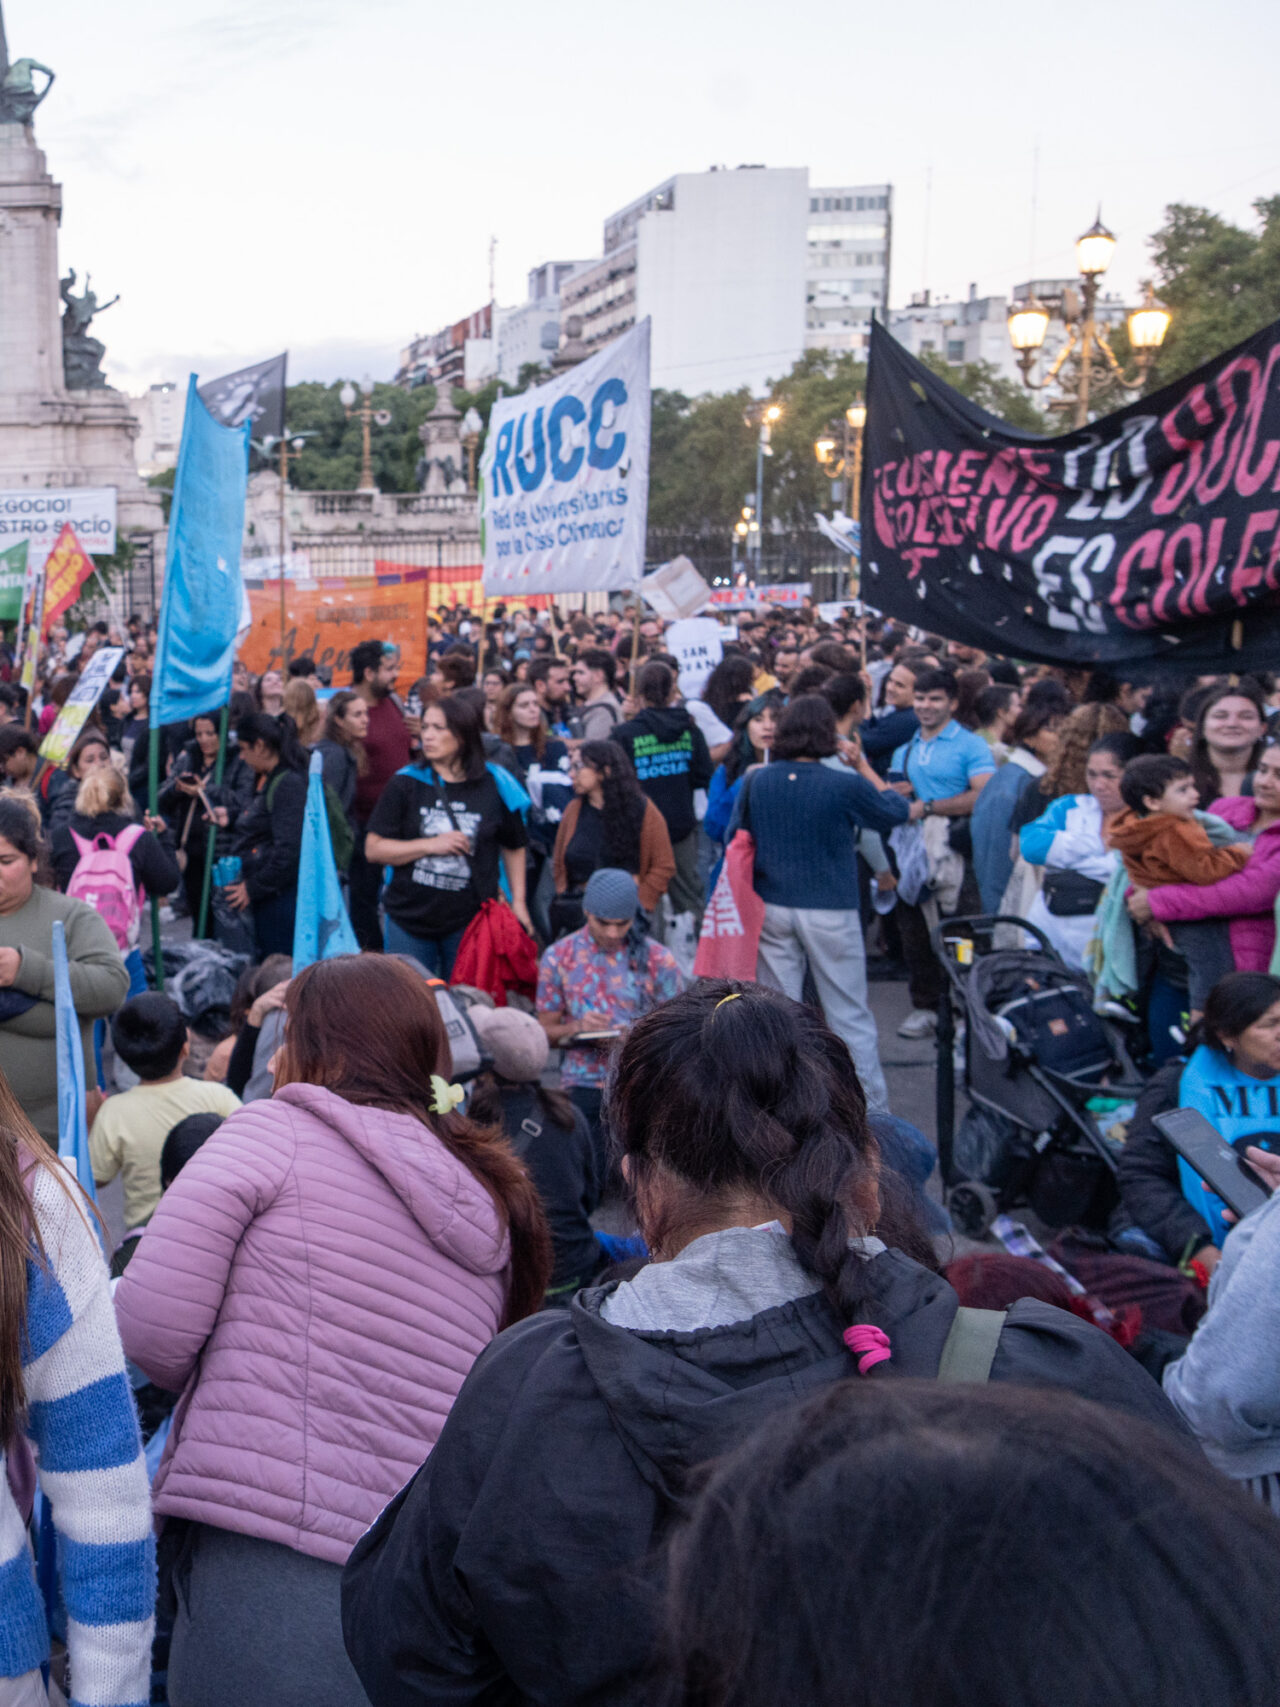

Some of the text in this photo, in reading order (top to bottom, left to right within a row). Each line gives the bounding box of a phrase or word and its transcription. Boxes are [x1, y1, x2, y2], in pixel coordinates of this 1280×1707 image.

[491, 377, 628, 498] RUCC
[1150, 342, 1280, 516] SOC
[1031, 508, 1280, 635] ES COLE
